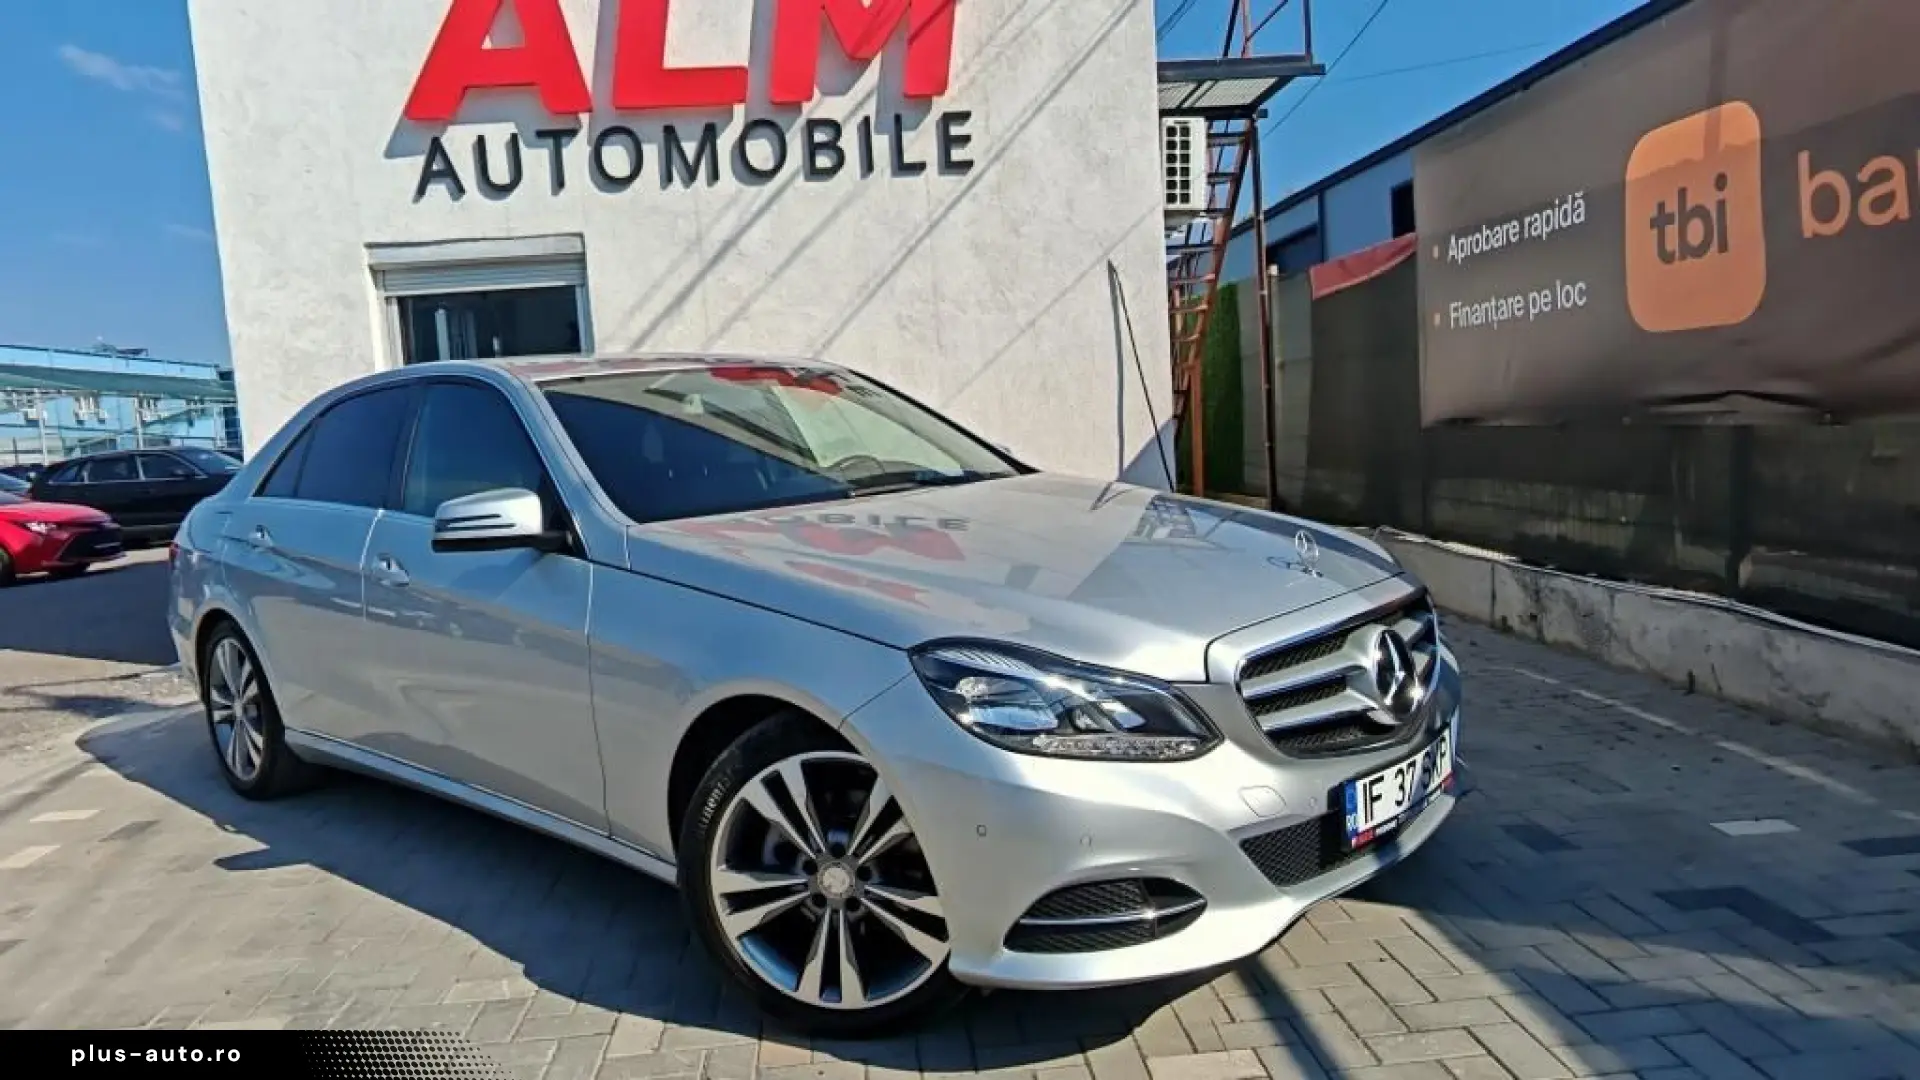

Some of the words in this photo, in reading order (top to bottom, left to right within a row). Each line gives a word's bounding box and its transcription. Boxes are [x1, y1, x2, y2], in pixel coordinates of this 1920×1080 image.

[413, 110, 975, 203] AUTOMOBILE
[1447, 219, 1520, 265] Aprobare
[1523, 190, 1586, 241] rapidă
[1649, 172, 1729, 265] tbi
[1797, 149, 1920, 239] ba
[1449, 294, 1525, 331] Finanțare
[1528, 288, 1552, 322] pe
[1555, 279, 1587, 310] loc
[1363, 774, 1385, 825] IF
[1394, 759, 1416, 807] 37
